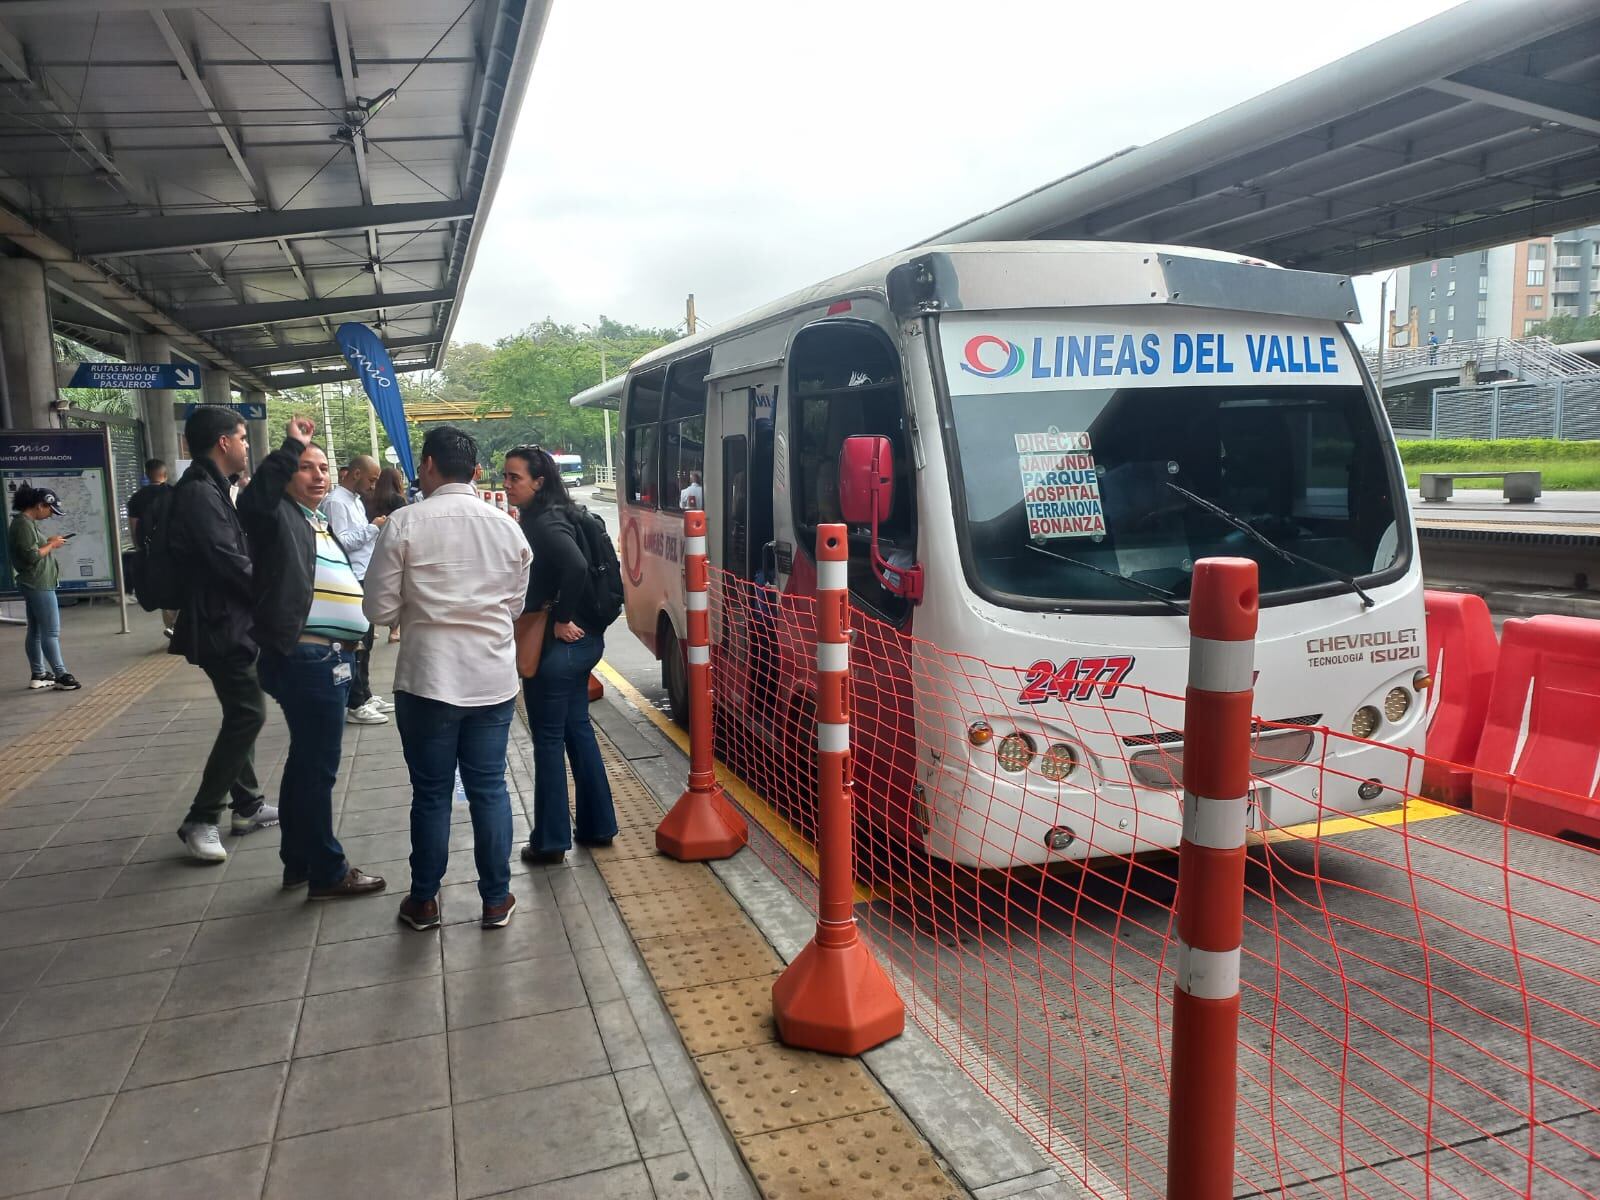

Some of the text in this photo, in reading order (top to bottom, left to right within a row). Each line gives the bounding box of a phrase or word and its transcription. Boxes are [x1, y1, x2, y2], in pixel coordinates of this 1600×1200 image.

[1032, 333, 1339, 379] LINEAS DEL VALLE
[93, 372, 157, 381] DESCENSO DE
[100, 380, 152, 388] PASAJEROS
[1017, 433, 1090, 451] DIRECTO
[1022, 455, 1094, 471] JAMUNDI
[1023, 470, 1097, 486] PARQUE
[1025, 485, 1099, 502] HOSPITAL
[1027, 500, 1101, 518] TERRANOVA
[1029, 516, 1104, 534] BONANZA
[1306, 628, 1418, 653] CHEVROLET
[1307, 646, 1420, 668] TECNOLOGIA ISUZU
[1017, 655, 1136, 705] 2477
